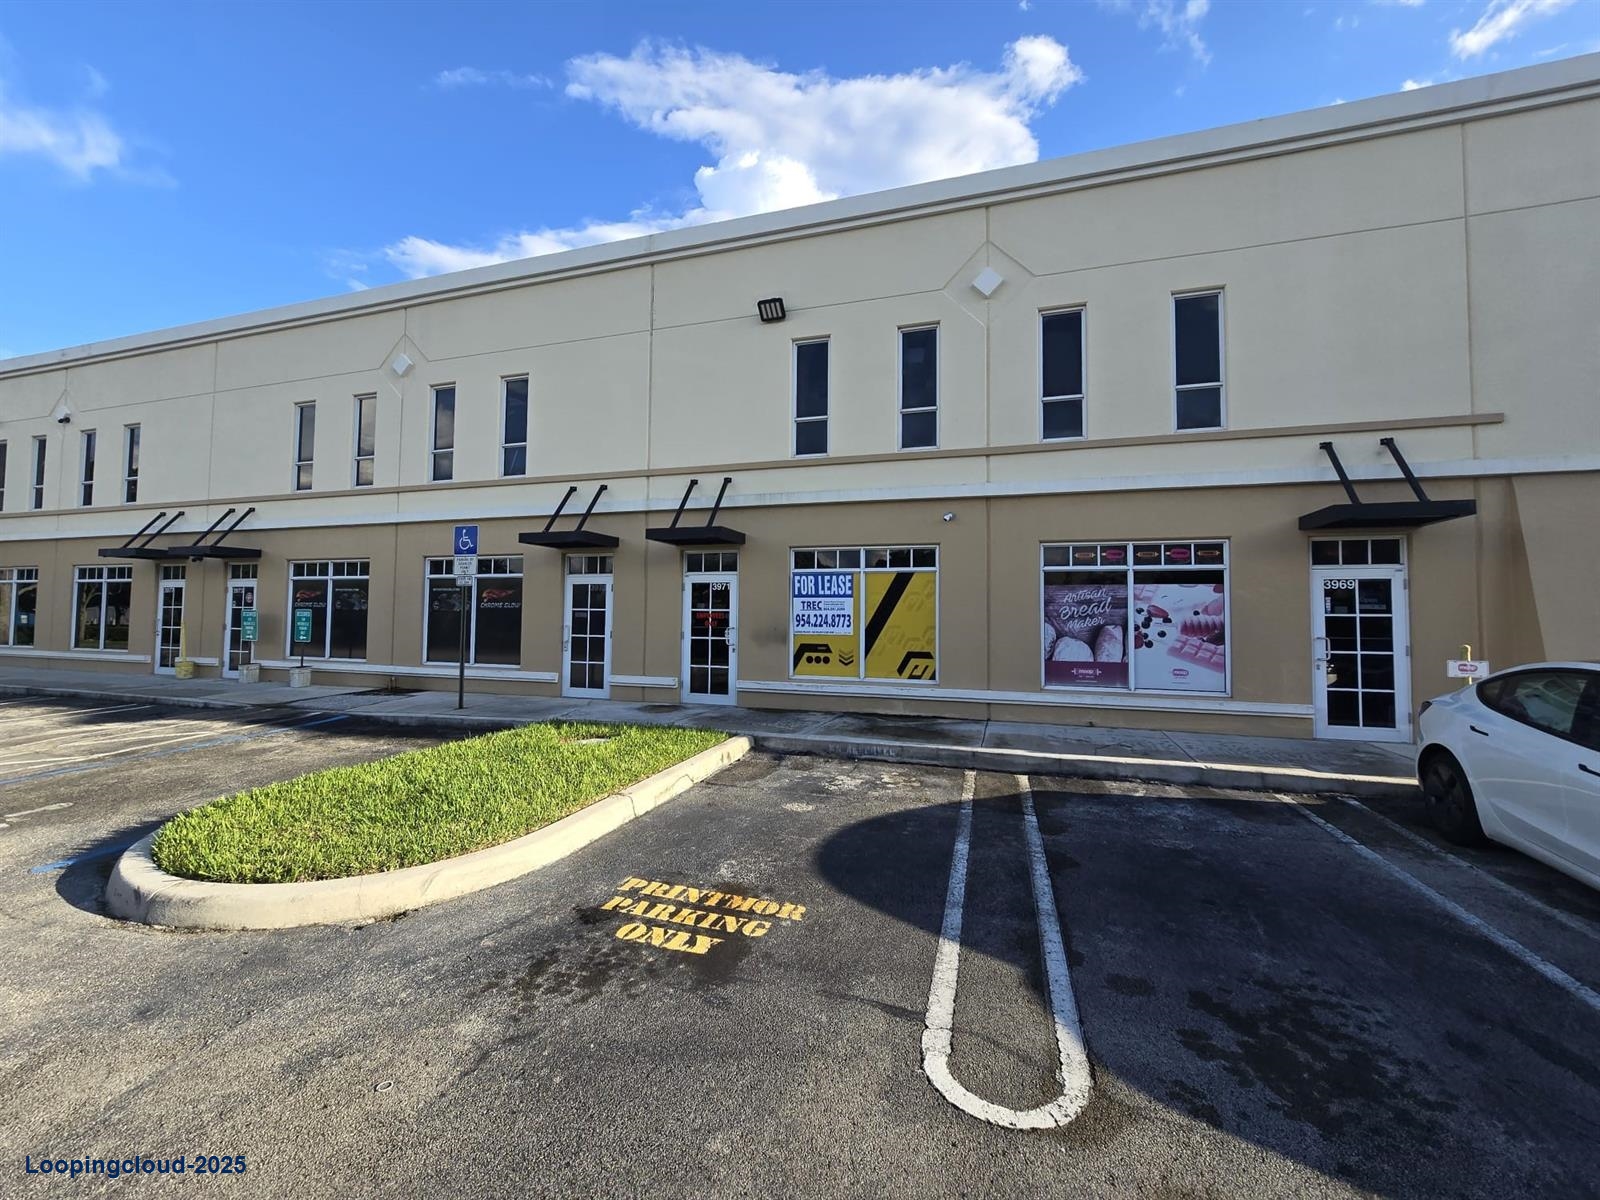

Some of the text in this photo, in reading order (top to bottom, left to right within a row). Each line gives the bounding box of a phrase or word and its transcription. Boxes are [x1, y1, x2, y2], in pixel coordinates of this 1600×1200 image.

[712, 583, 730, 591] 3971
[794, 575, 852, 595] FOR LEASE
[1323, 579, 1355, 590] 3969
[1063, 588, 1109, 603] Artisan
[800, 601, 822, 610] TREC
[1059, 597, 1112, 620] Bread
[795, 613, 852, 628] 954.224.8773
[1066, 616, 1105, 629] Maker
[616, 875, 807, 922] PRINTMOR
[600, 895, 773, 938] PARKING
[615, 921, 725, 955] ONLY
